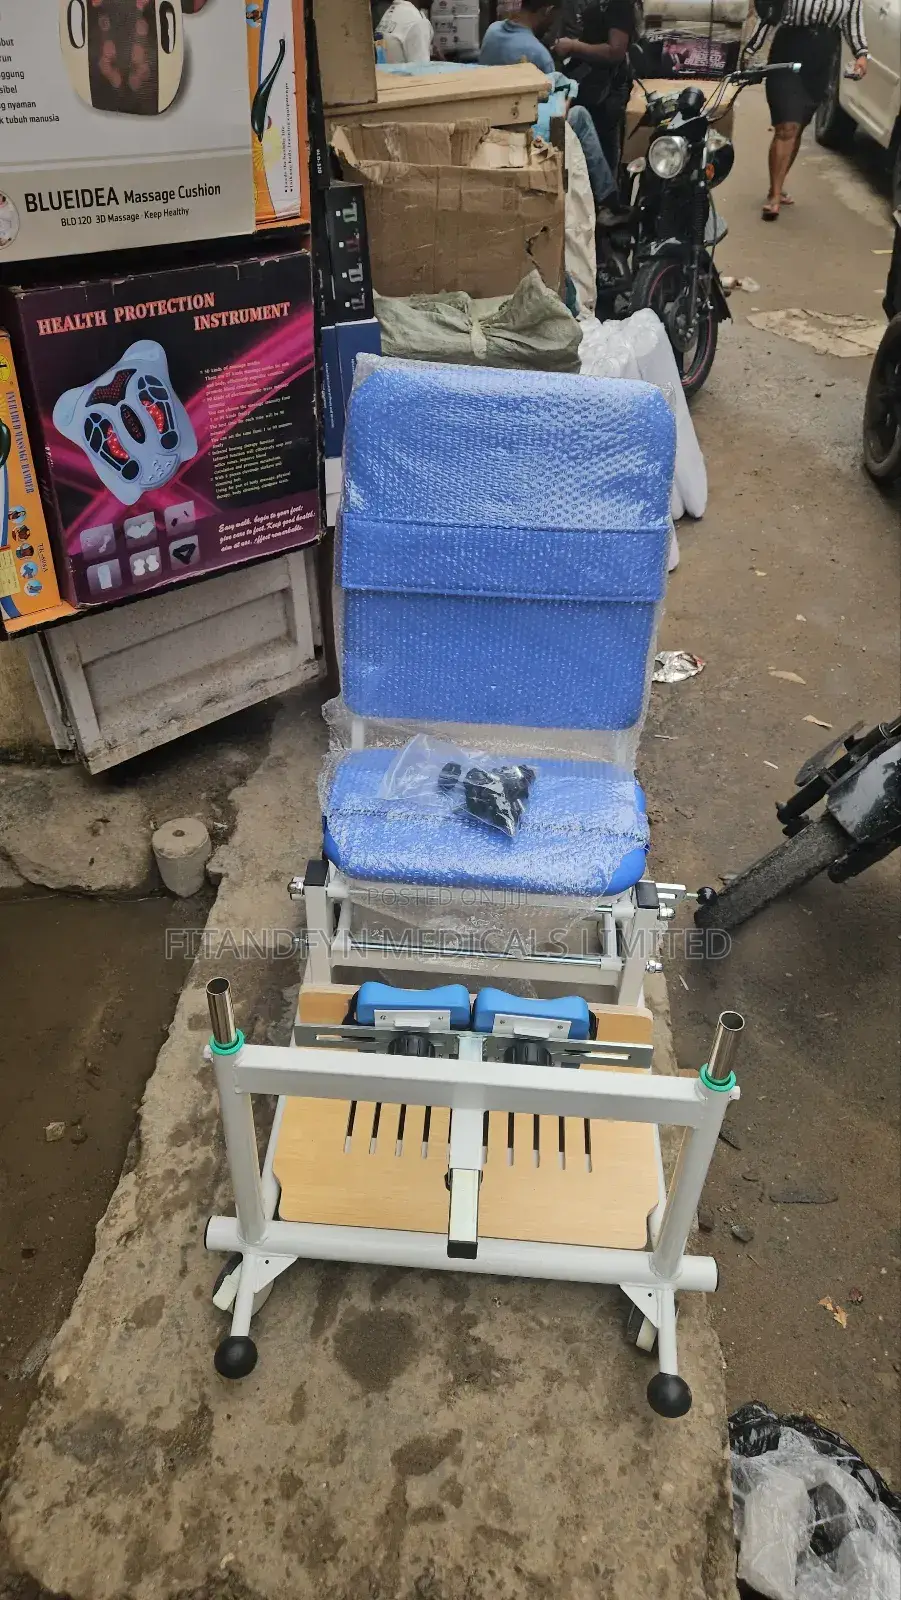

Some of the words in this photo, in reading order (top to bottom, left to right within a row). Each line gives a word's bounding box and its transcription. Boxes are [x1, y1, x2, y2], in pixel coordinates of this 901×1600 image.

[0, 71, 24, 80] ggung
[8, 101, 36, 110] nyaman
[30, 114, 59, 122] manusia
[24, 186, 120, 212] BLUEIDEA
[124, 190, 176, 204] Massage
[178, 183, 221, 198] Cushion
[61, 217, 76, 227] BLD
[78, 216, 92, 225] 120
[96, 214, 106, 223] 3D
[108, 214, 140, 222] Massage
[144, 210, 162, 219] Keep
[164, 207, 190, 216] Healthy
[36, 310, 108, 336] HEALTH
[113, 292, 215, 323] PROTECTION
[194, 302, 290, 331] INSTRUMENT
[14, 431, 28, 463] MASSAGE
[21, 463, 34, 493] HAMMER
[219, 524, 235, 532] Easy
[254, 515, 269, 523] begin
[277, 509, 289, 518] your
[282, 516, 295, 527] good
